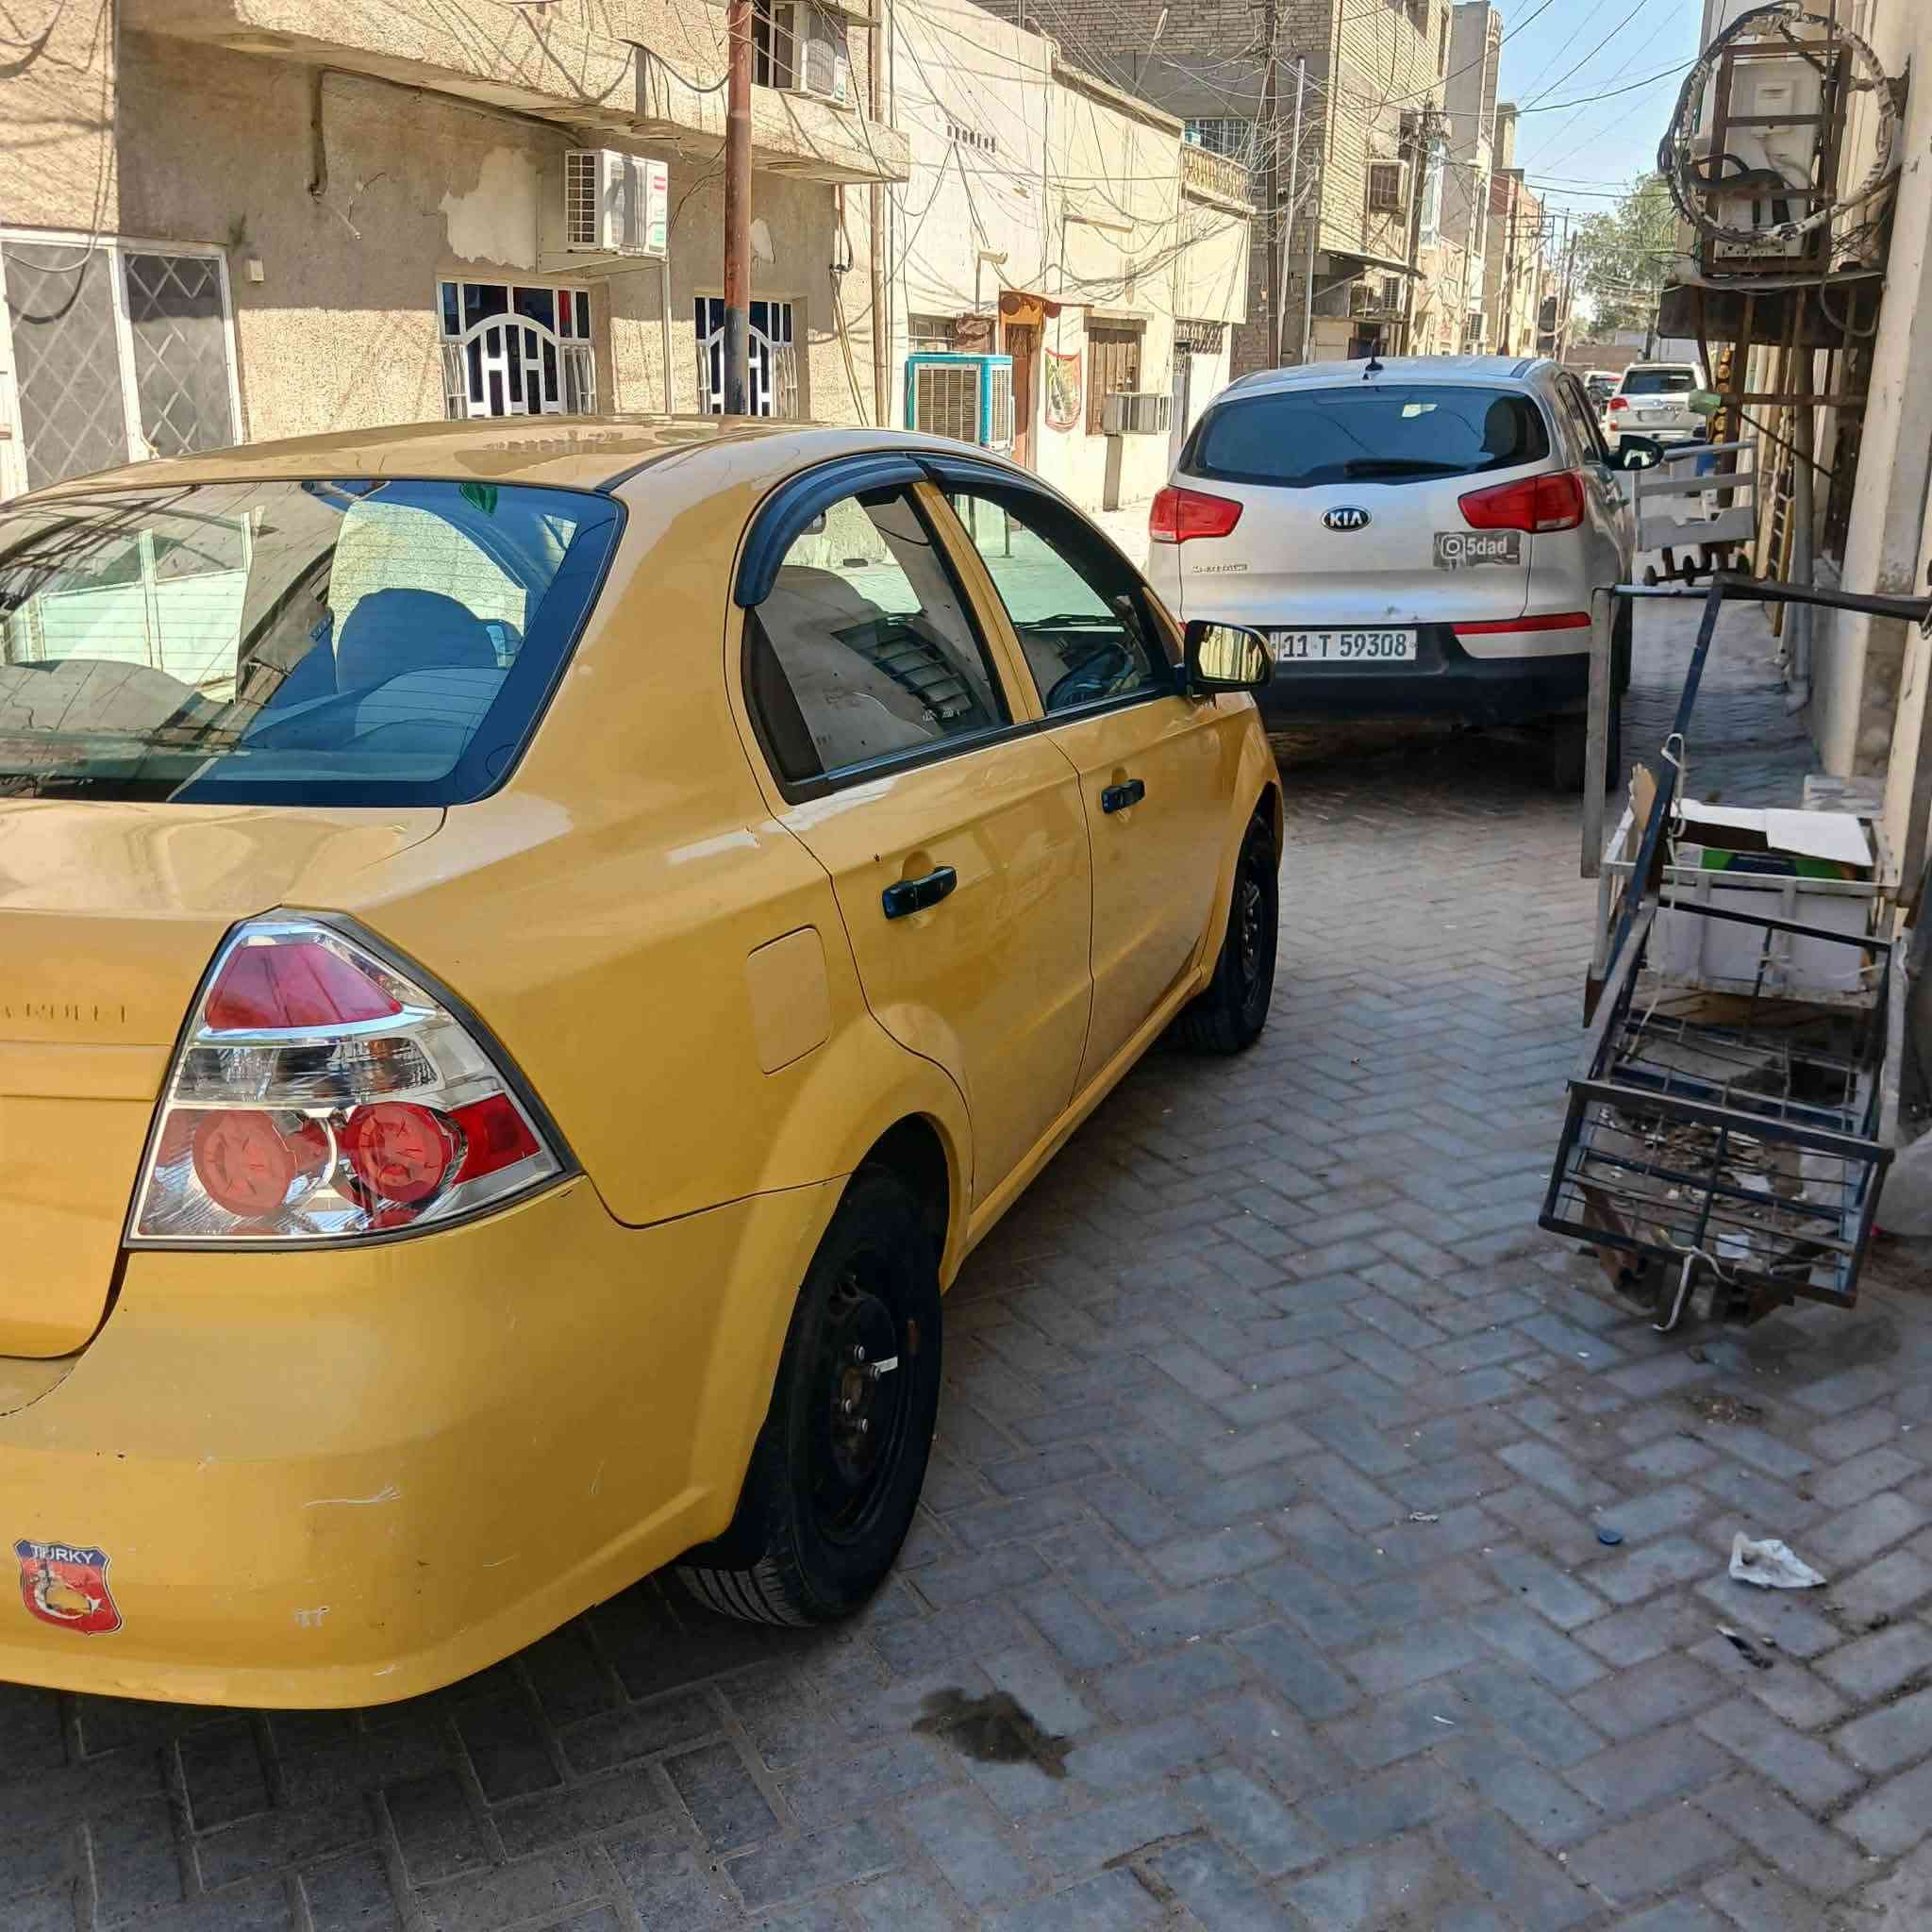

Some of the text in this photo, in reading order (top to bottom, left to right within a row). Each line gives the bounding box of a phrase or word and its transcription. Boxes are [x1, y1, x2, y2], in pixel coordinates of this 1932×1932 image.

[1330, 510, 1363, 526] KIA
[1283, 633, 1308, 658] 11
[1319, 634, 1331, 658] T
[1340, 633, 1407, 658] 59308
